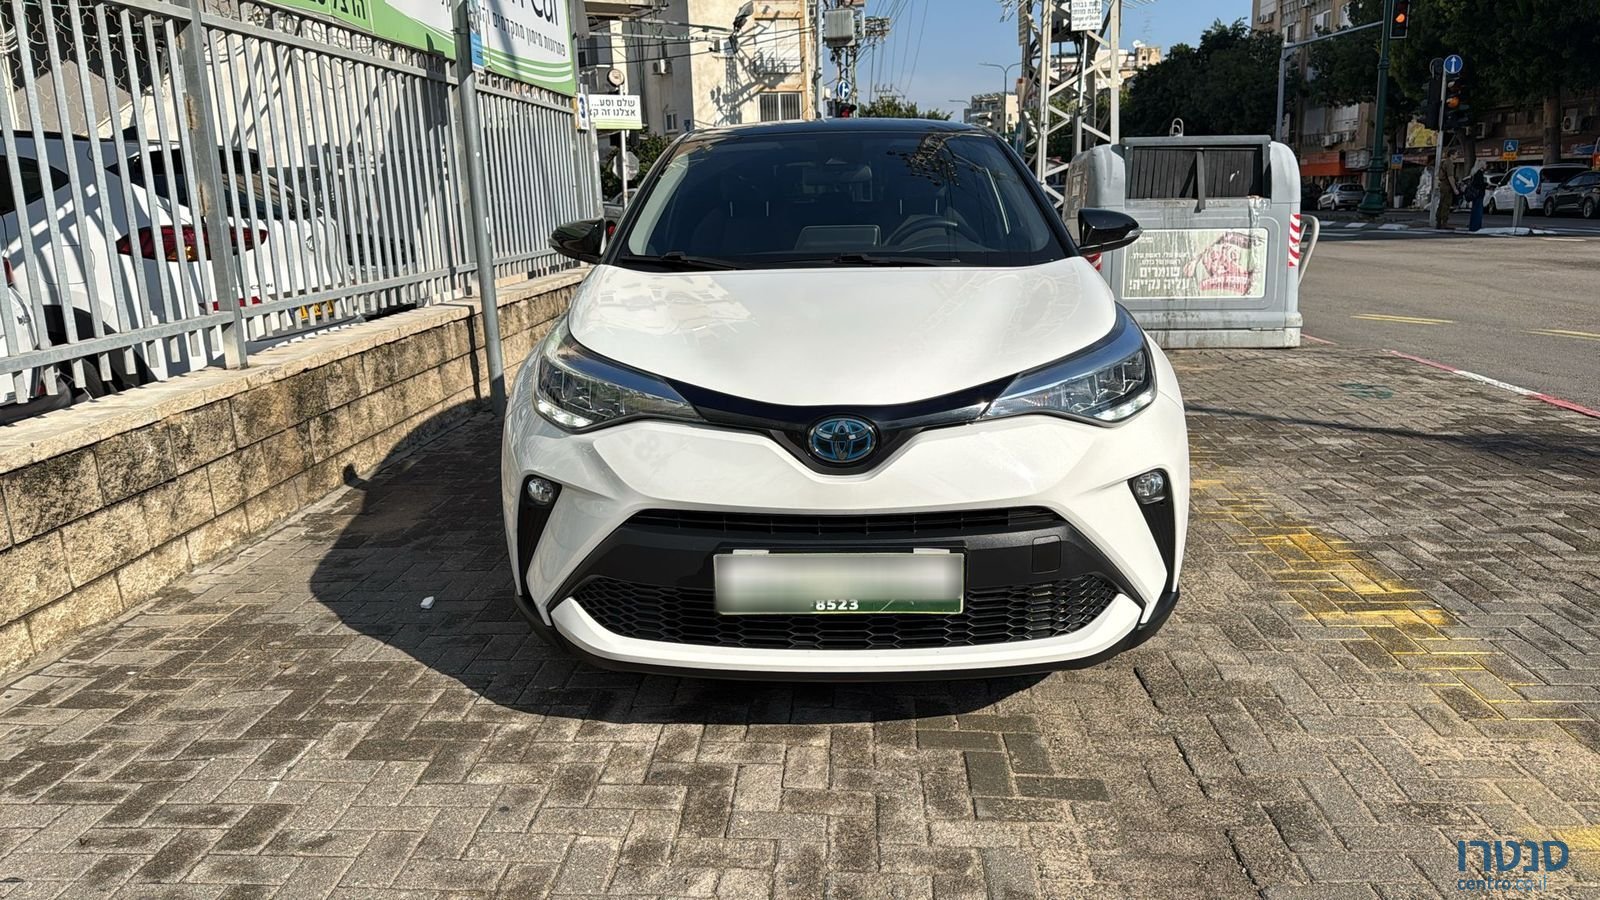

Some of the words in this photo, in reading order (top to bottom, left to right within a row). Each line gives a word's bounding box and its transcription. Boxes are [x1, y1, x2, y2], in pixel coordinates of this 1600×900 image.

[616, 98, 636, 107] שלם
[601, 108, 612, 116] זה
[613, 107, 636, 117] אצלנו
[1139, 266, 1180, 278] שומרים
